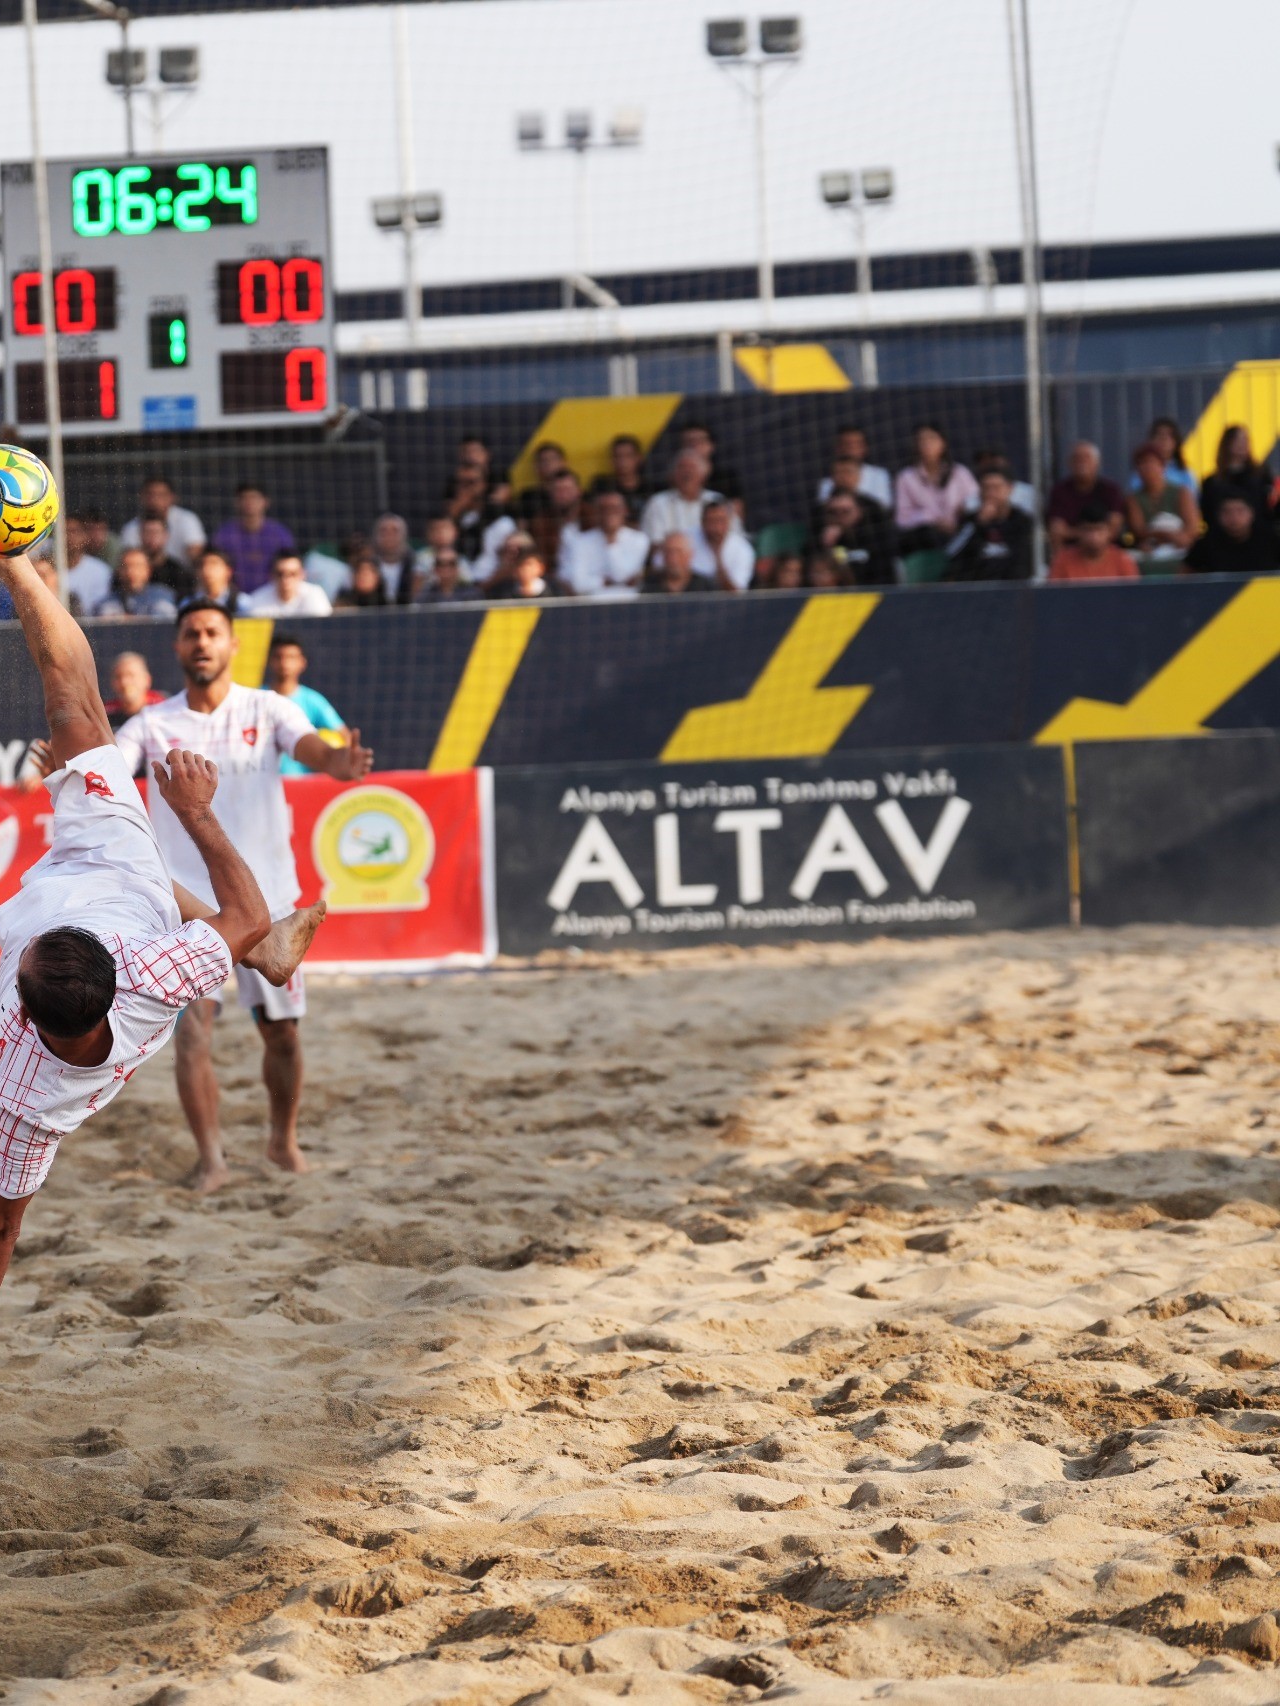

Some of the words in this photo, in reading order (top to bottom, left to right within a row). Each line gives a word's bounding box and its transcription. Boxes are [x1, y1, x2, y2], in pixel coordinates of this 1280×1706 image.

[73, 163, 257, 237] 06:24
[239, 258, 324, 327] 00
[169, 319, 186, 365] 1
[99, 360, 117, 420] 1
[285, 346, 328, 413] 0
[559, 784, 656, 816] Alanya
[659, 780, 757, 809] Turizm
[547, 795, 973, 912] ALTAV
[633, 907, 725, 933] Tourism
[725, 902, 844, 931] Promotion
[845, 896, 977, 925] Foundation
